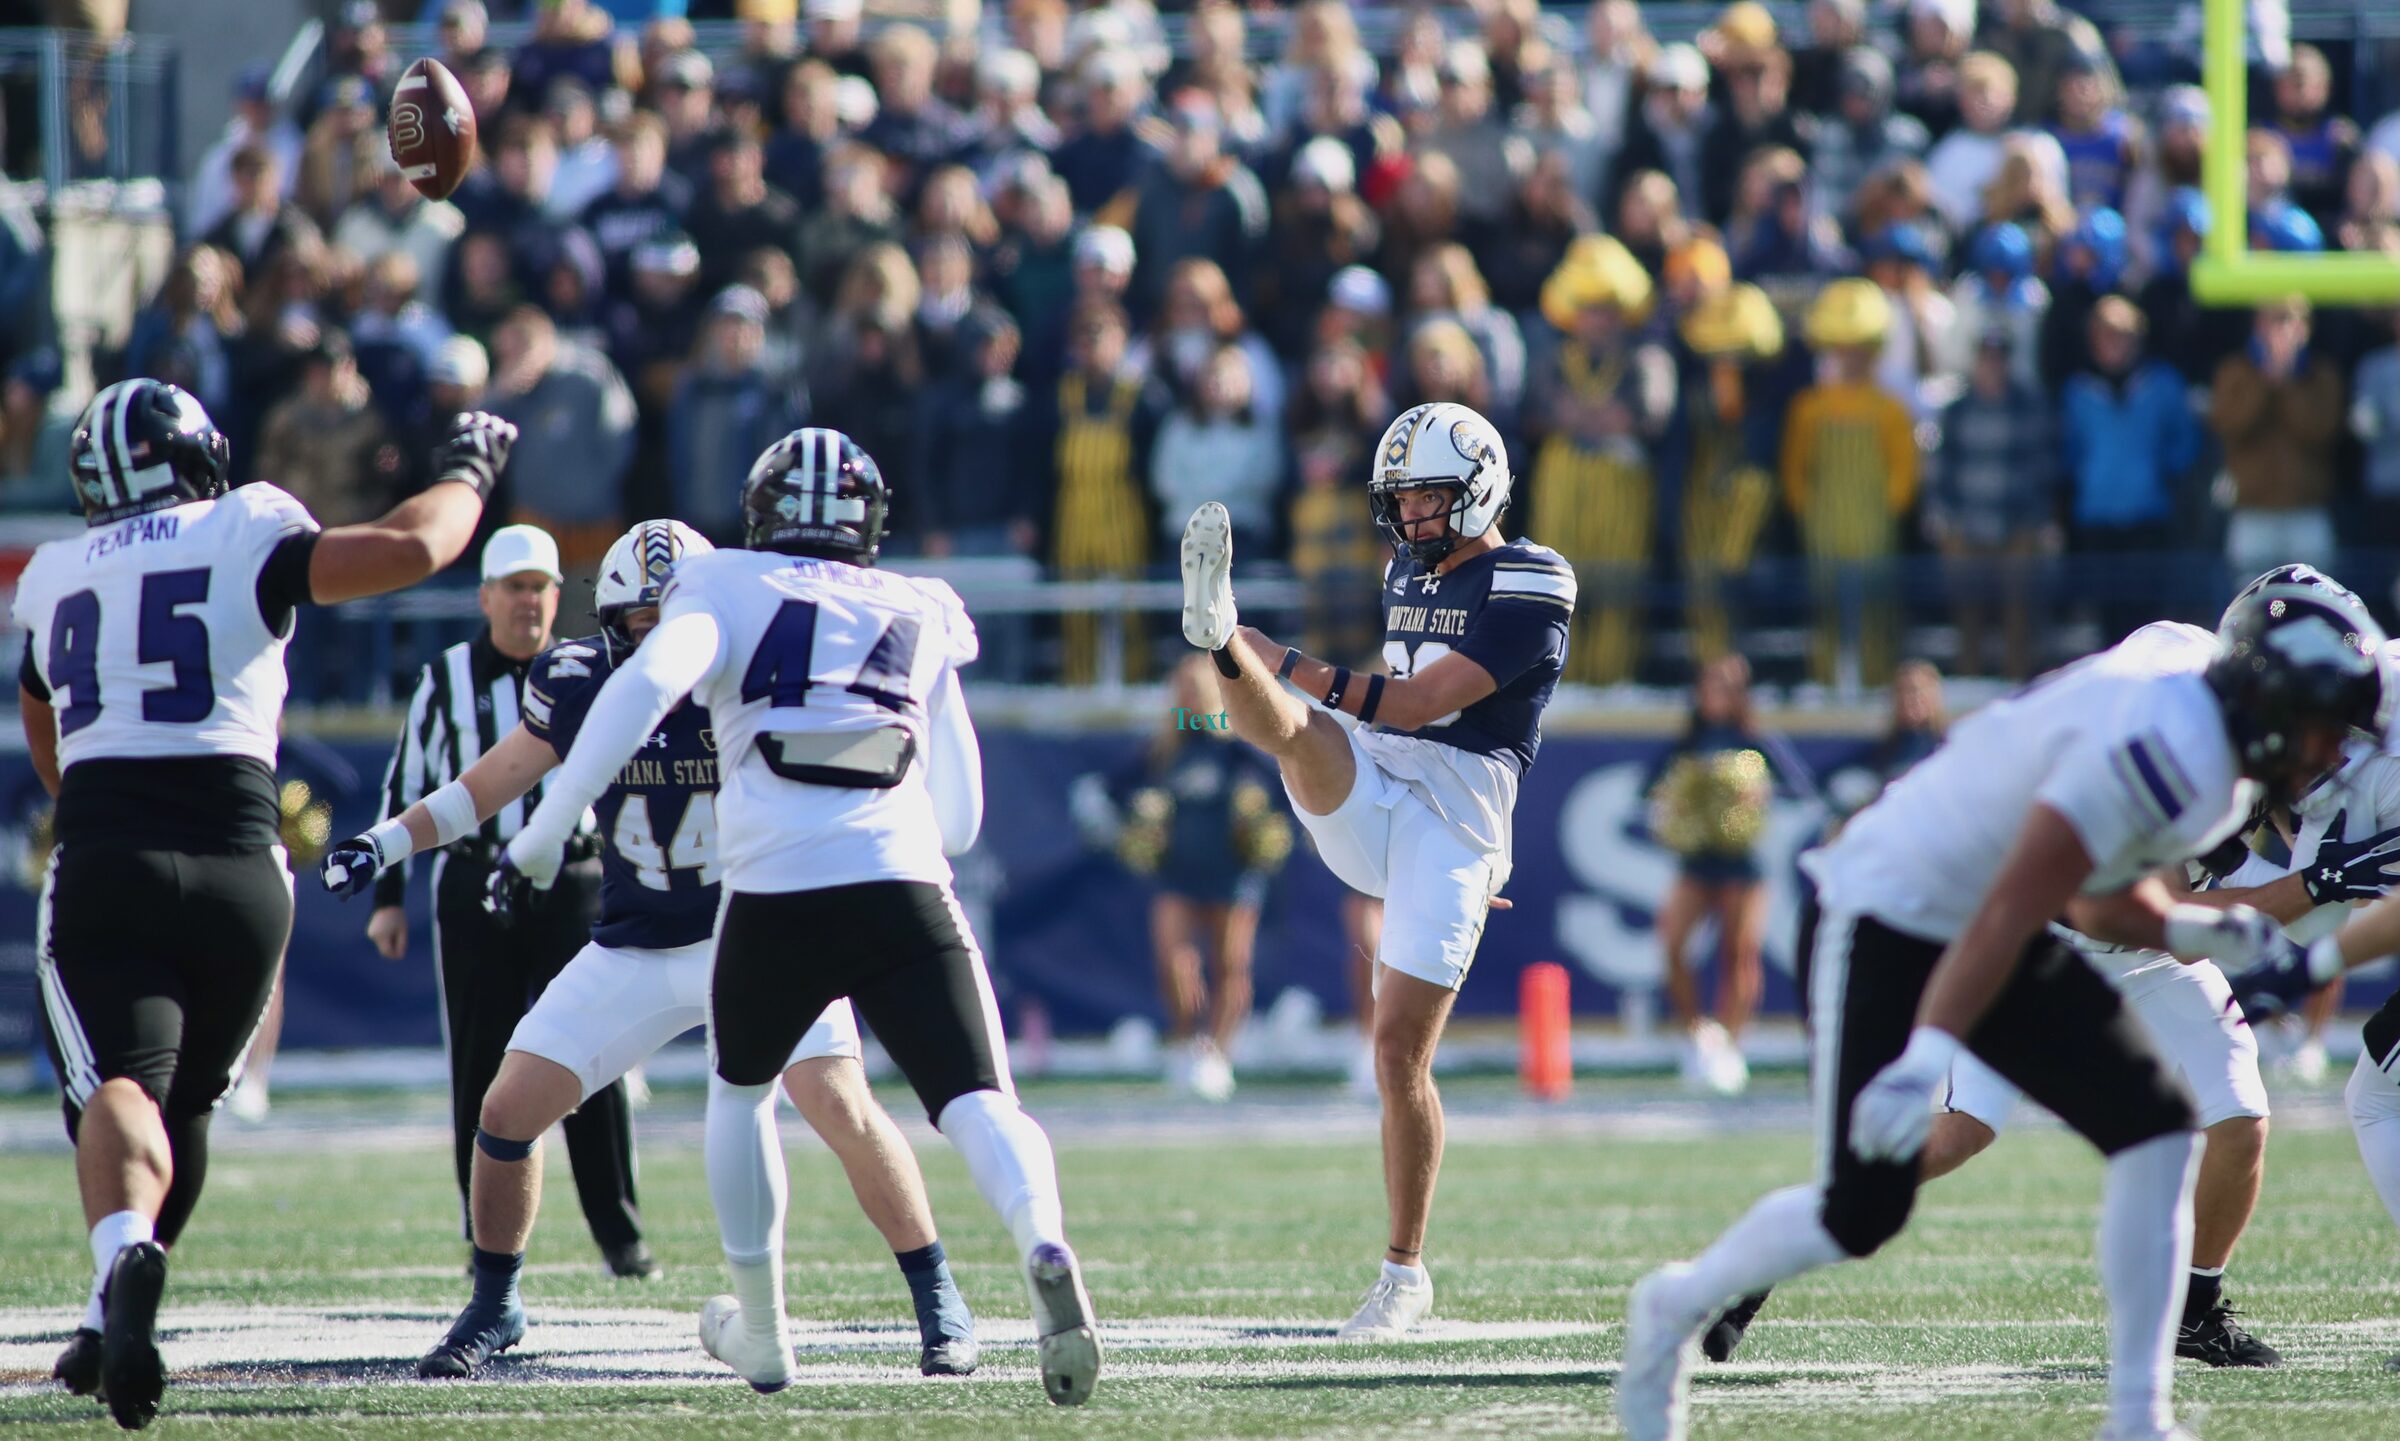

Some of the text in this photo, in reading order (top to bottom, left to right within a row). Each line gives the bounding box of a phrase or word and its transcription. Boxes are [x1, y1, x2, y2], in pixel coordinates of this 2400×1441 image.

[1386, 471, 1401, 480] 406
[1429, 608, 1468, 635] STATE
[48, 566, 216, 739] 95
[547, 643, 598, 680] 44
[740, 598, 921, 714] 44
[611, 759, 667, 785] TANA
[613, 790, 722, 892] 44
